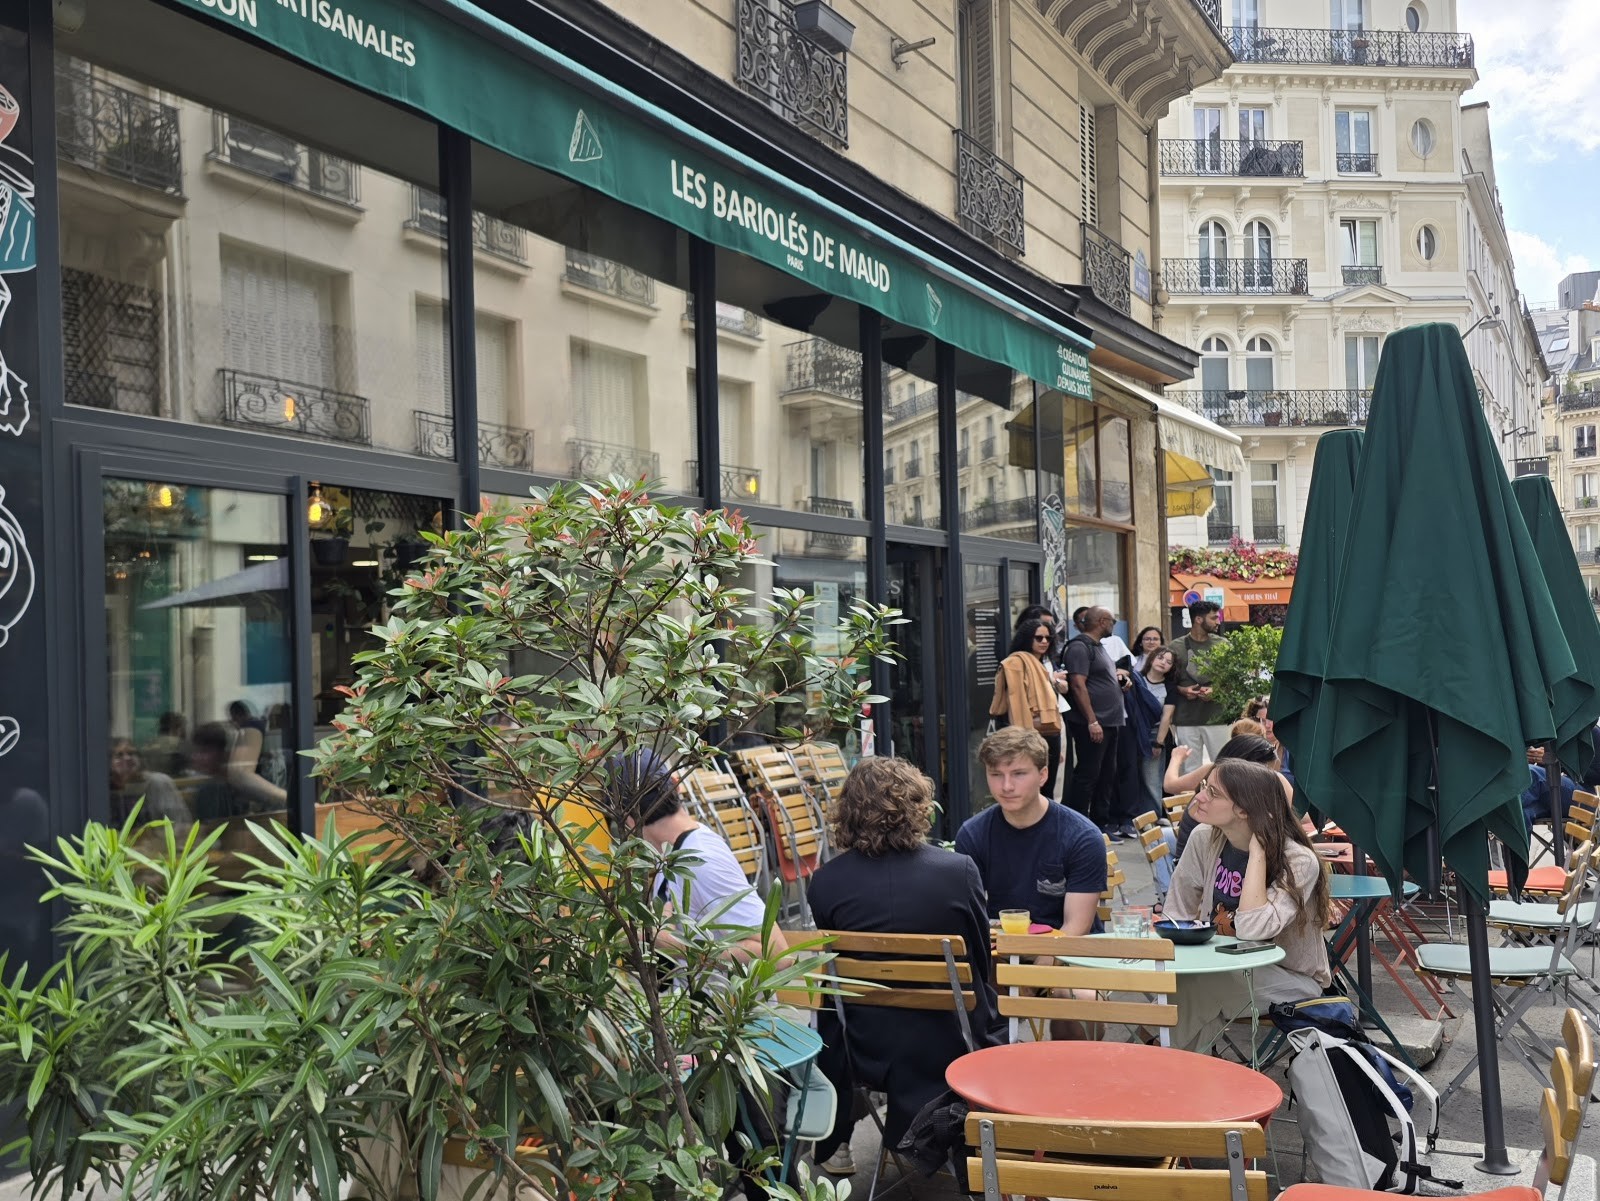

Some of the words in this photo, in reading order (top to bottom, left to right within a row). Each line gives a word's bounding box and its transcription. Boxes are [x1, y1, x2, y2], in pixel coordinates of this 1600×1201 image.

[671, 159, 707, 209] LES
[713, 181, 809, 256] BARIOLÉS
[813, 230, 835, 269] DE
[840, 244, 890, 292] MAUD
[787, 253, 804, 272] PARIS
[1063, 348, 1087, 368] CRÉATION
[1062, 362, 1090, 382] CULINAIRE
[1057, 375, 1077, 392] DEPUIS
